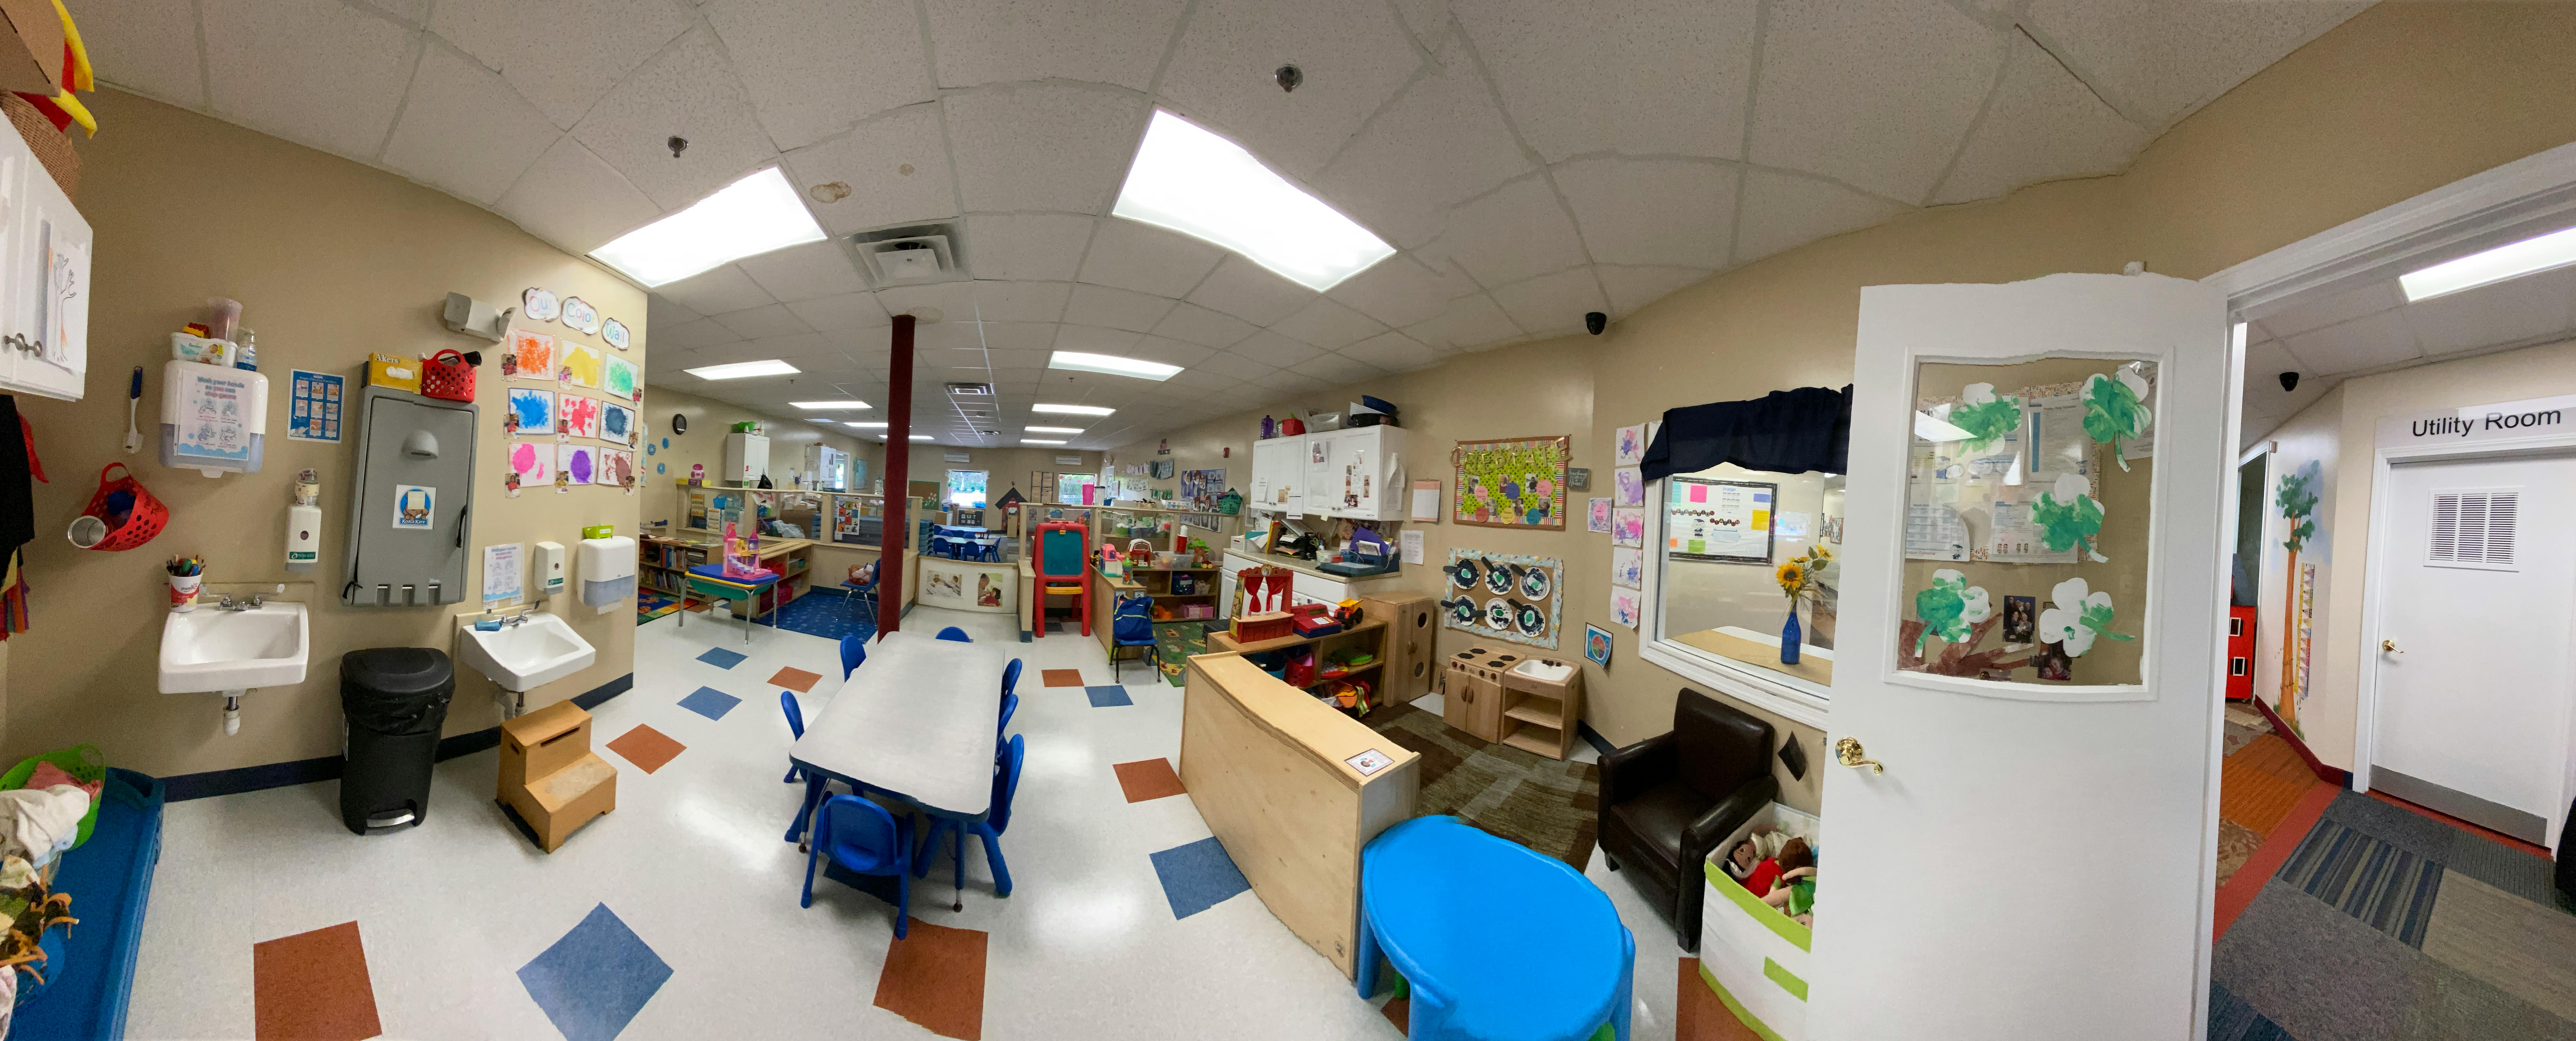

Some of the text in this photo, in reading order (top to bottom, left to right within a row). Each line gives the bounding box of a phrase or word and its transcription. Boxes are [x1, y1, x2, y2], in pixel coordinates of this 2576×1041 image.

[567, 302, 595, 324] Color
[606, 322, 625, 343] Wall
[375, 354, 400, 364] Akers
[2412, 410, 2561, 437] Utility Room
[1449, 436, 1574, 476] CELEBRATE
[1671, 508, 1714, 517] NFORMATION
